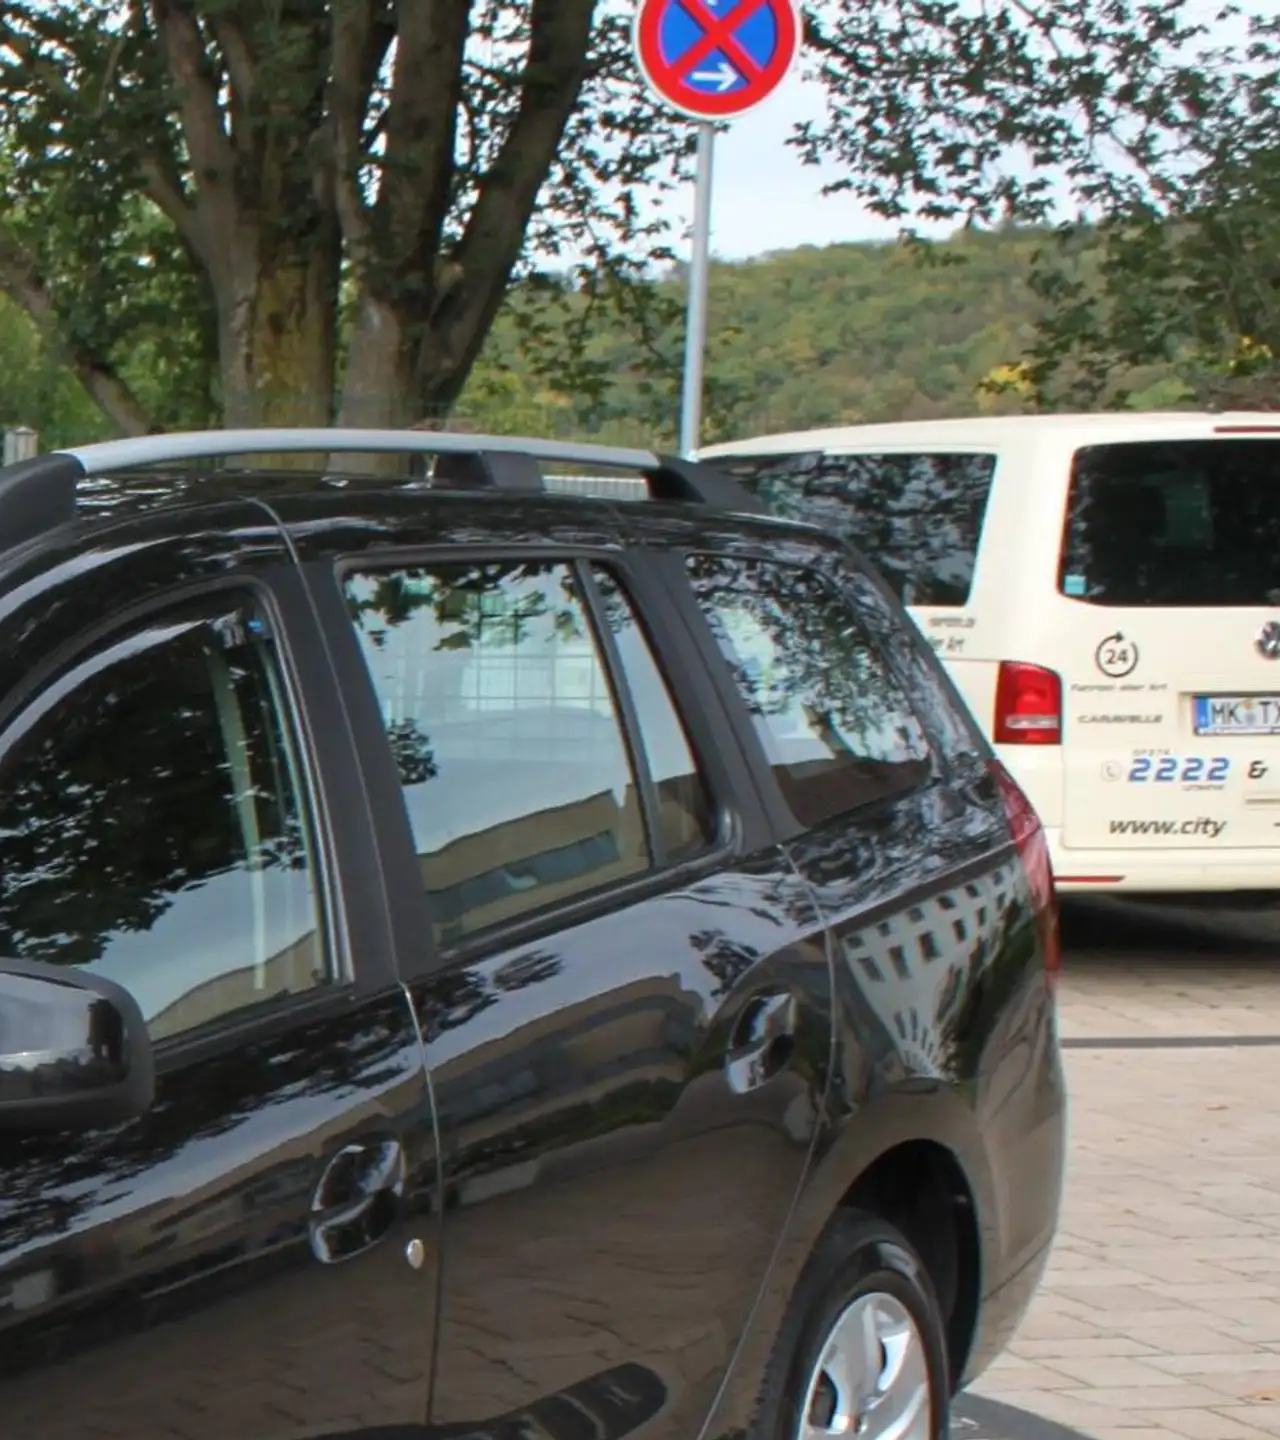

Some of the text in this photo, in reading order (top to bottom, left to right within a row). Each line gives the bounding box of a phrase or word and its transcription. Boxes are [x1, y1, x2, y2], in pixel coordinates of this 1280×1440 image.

[1105, 649, 1128, 664] 24
[1211, 701, 1241, 724] MK
[1127, 757, 1268, 782] 2222 &
[1109, 816, 1227, 837] www.city
